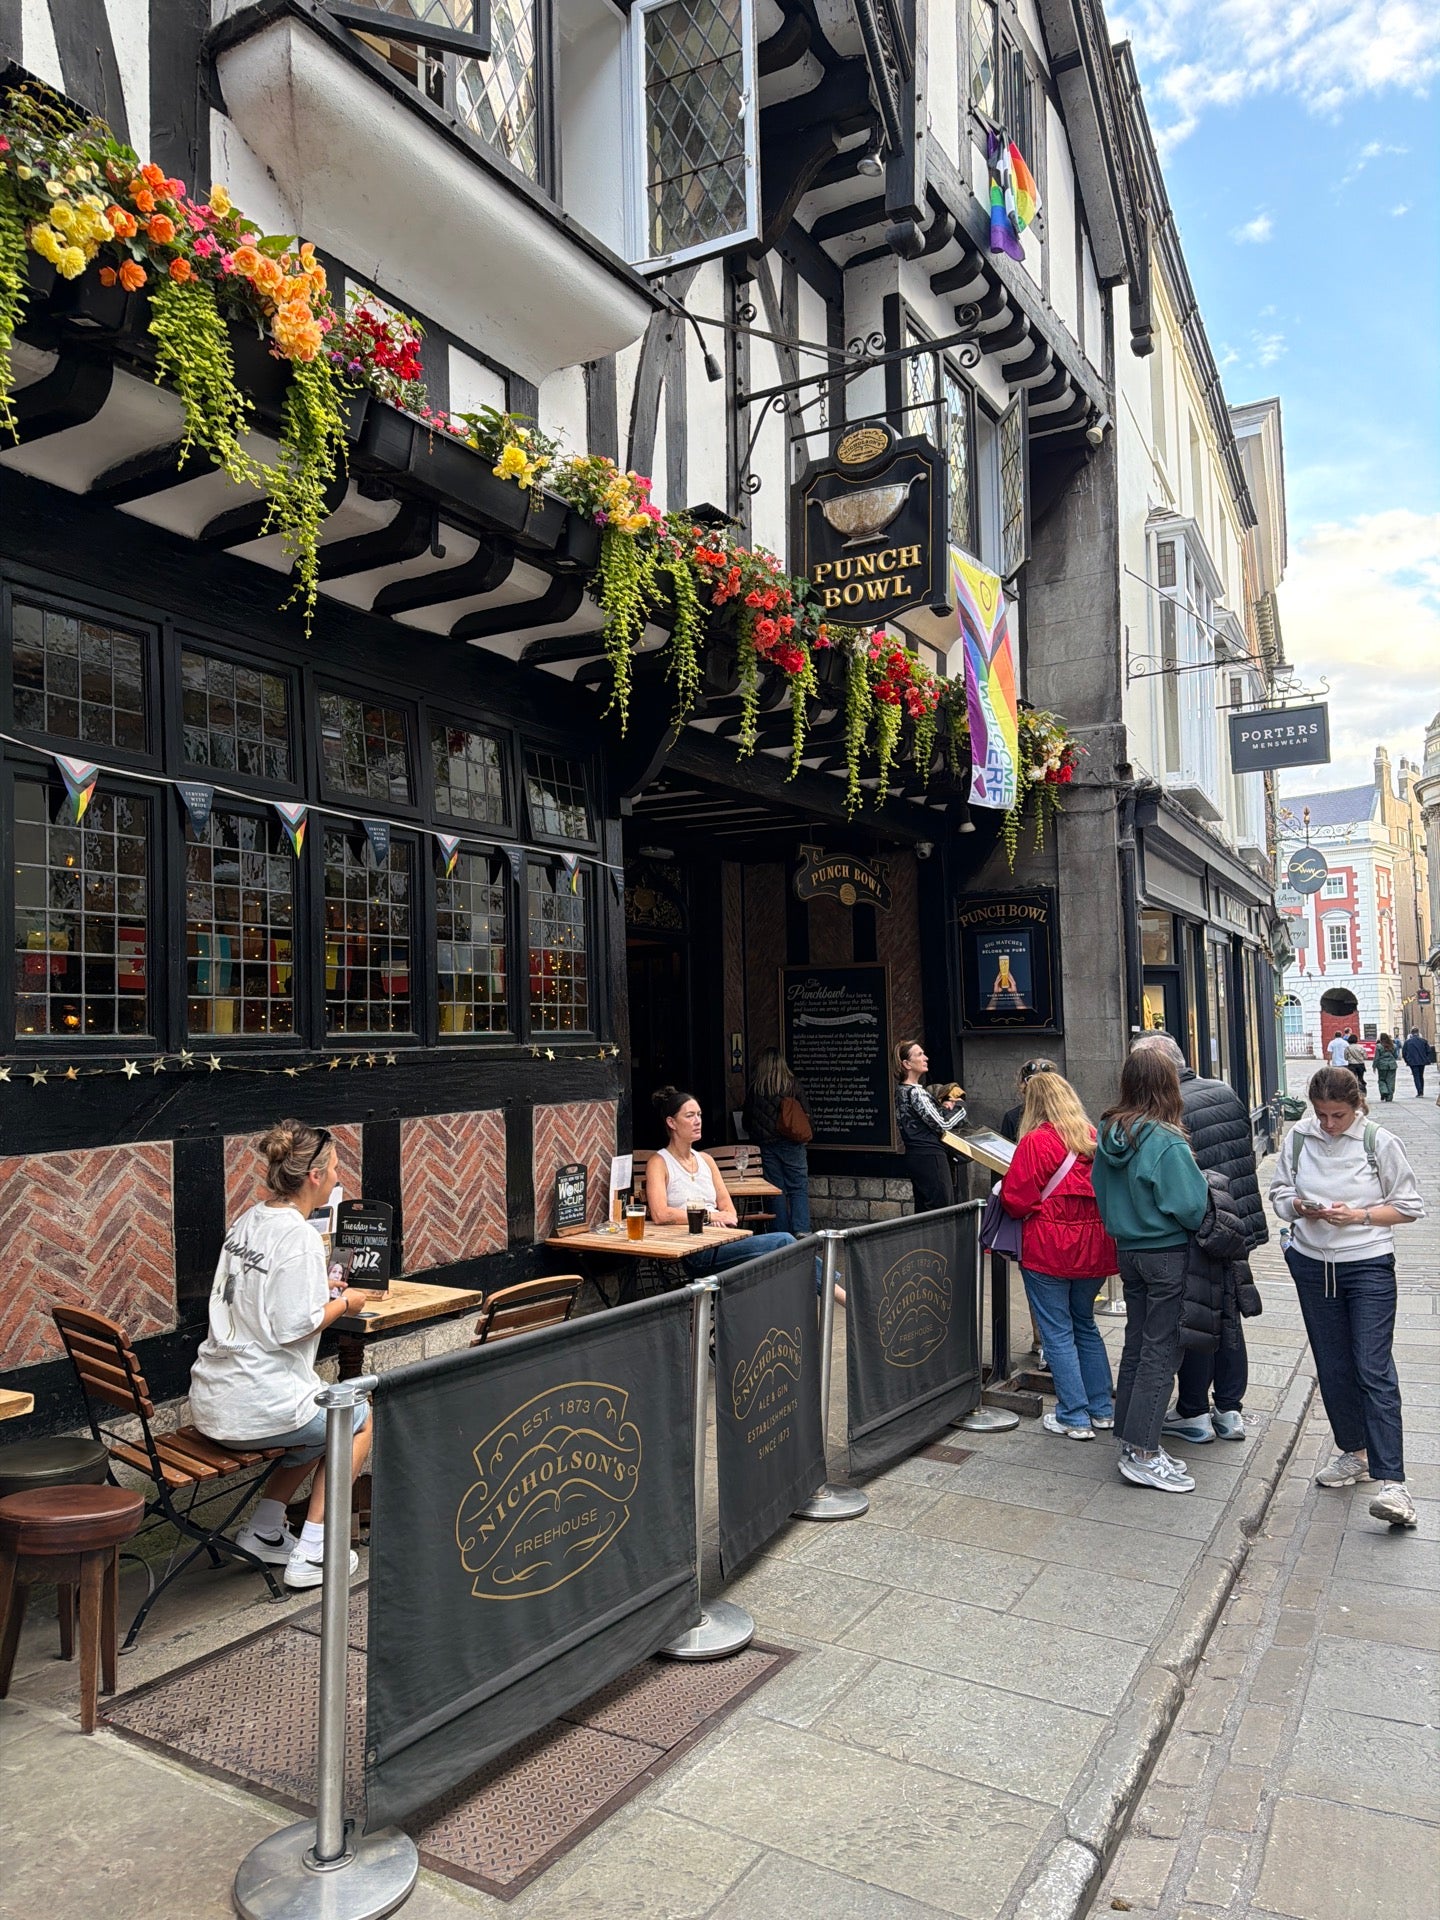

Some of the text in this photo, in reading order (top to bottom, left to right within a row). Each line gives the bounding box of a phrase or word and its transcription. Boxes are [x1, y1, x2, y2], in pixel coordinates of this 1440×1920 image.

[812, 544, 922, 585] PUNCH
[822, 575, 912, 609] BOWL
[979, 684, 1013, 803] WELCOME
[1241, 723, 1318, 743] PORTERS
[1252, 737, 1308, 750] MENSWEAR
[986, 741, 1003, 803] ERE
[811, 864, 882, 898] PUNCH BOWL
[959, 904, 1048, 927] PUNCH BOWL
[984, 939, 1023, 949] BIG MATCHES
[787, 984, 846, 1001] Punchbowl
[558, 1181, 585, 1200] WORLD
[567, 1194, 584, 1206] CUP
[341, 1219, 369, 1233] Tuesday
[341, 1234, 389, 1248] GENERAL KNOWLEDGE
[351, 1246, 380, 1273] uiz
[886, 1287, 948, 1331] NICHOLSON'S
[899, 1323, 934, 1345] FREEHOUSE
[742, 1344, 799, 1400] NICHOLSON'S
[758, 1383, 789, 1412] ALE & GIN
[521, 1399, 591, 1437] EST. 1873
[746, 1398, 798, 1443] ESTABLISHMENTS
[758, 1426, 790, 1460] SINCE 1873
[477, 1450, 626, 1544] NICHOLSON'S
[514, 1508, 598, 1559] FREEHOUSE
